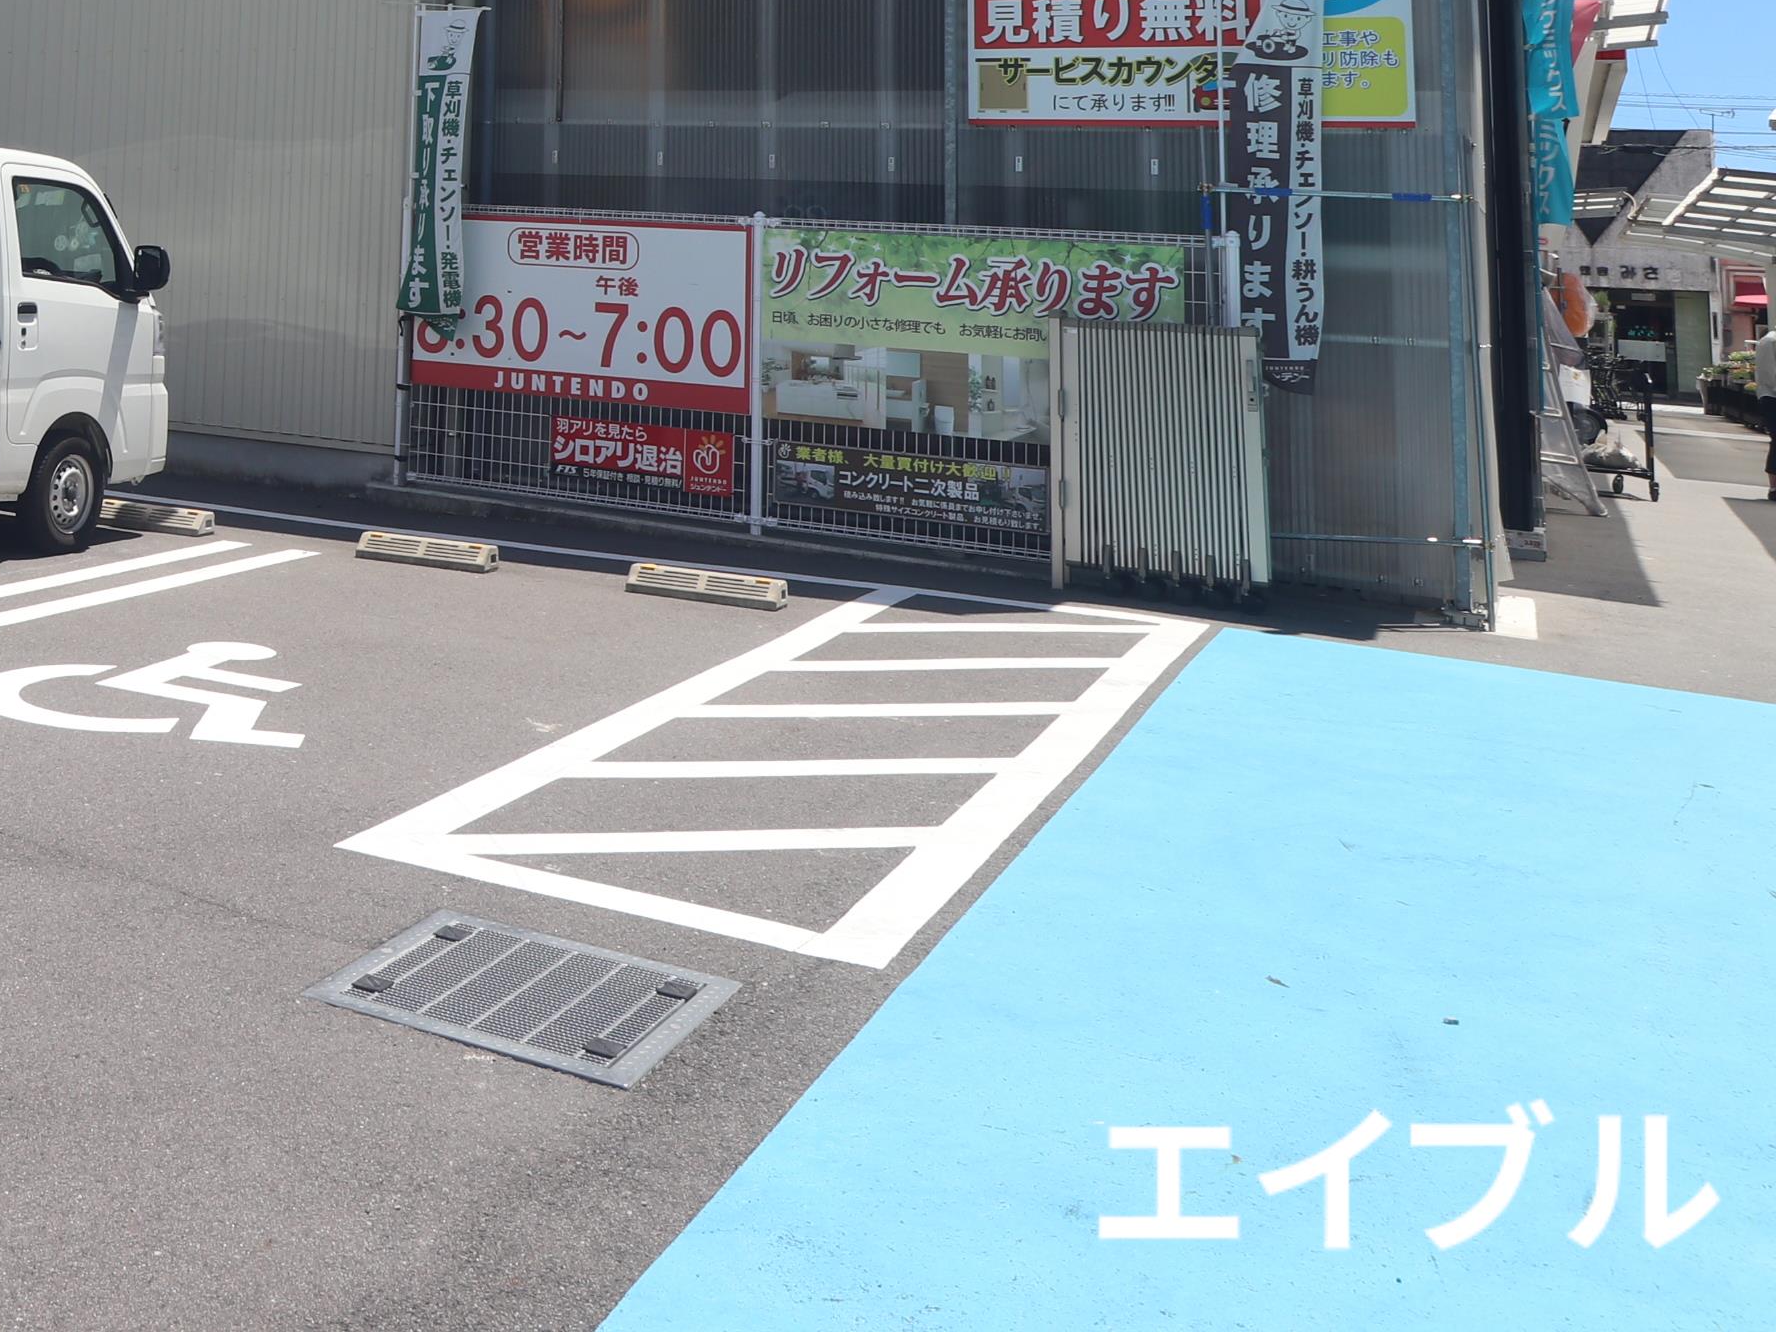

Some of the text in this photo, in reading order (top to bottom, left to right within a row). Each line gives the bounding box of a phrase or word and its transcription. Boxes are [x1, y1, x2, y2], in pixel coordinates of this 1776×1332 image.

[407, 81, 441, 309] 下取り承ります
[517, 231, 629, 265] 営業時間
[595, 275, 639, 298] 午後
[772, 249, 1176, 318] リフォーム承ります
[494, 370, 649, 402] JUNTENDO
[556, 417, 648, 442] 羽アリを見たら
[553, 435, 683, 475] シロアリ退治
[838, 471, 980, 502] コンクリート二次製品
